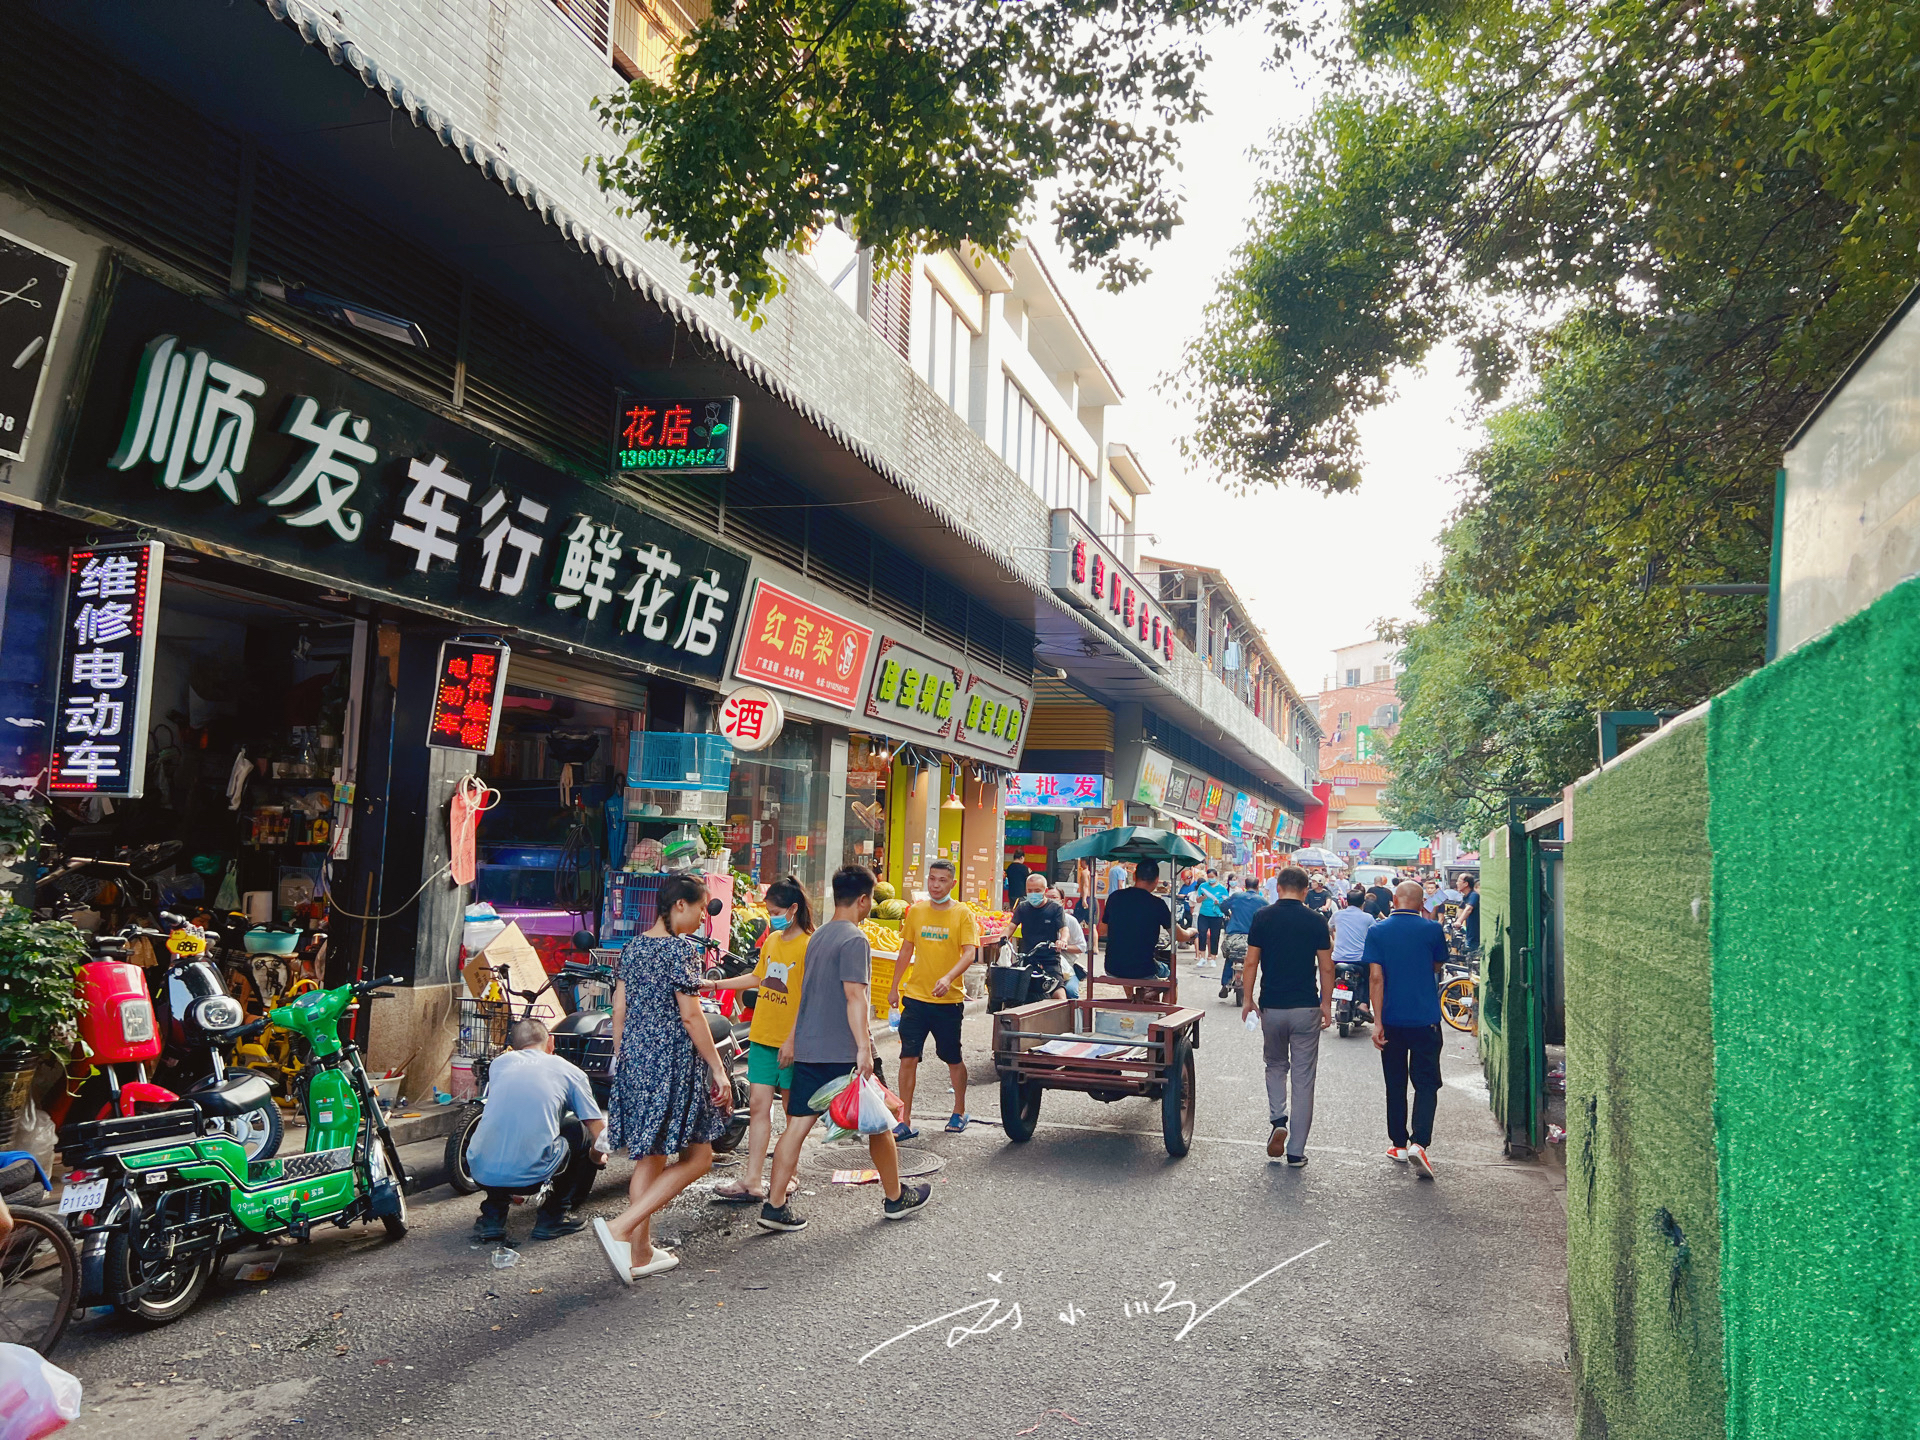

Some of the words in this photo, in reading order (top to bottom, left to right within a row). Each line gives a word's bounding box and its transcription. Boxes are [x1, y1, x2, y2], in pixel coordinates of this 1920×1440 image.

[623, 404, 692, 448] 花店
[619, 448, 726, 467] 13609754542
[760, 604, 834, 666] 红高梁
[838, 636, 857, 675] 酒
[60, 555, 139, 784] 维修电动车
[436, 657, 469, 735] 电动车
[460, 654, 495, 744] 配件维修
[724, 698, 769, 740] 酒
[757, 990, 788, 1005] ACHA
[61, 1192, 101, 1210] P11233
